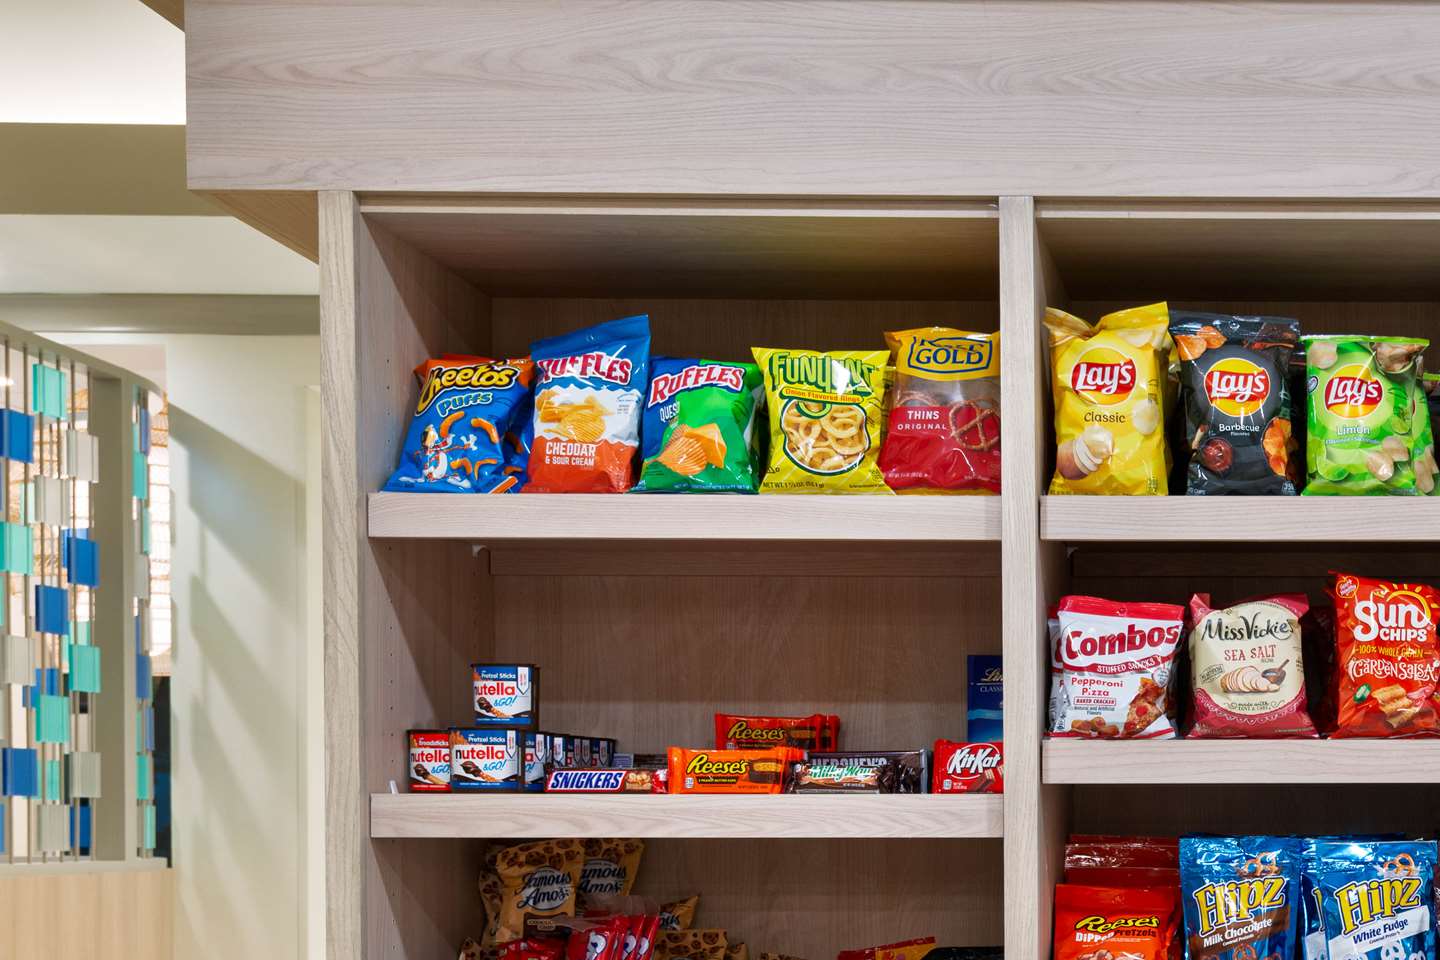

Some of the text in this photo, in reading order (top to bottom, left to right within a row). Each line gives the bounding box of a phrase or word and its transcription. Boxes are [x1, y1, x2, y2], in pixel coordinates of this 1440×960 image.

[916, 347, 984, 365] GOLD
[1076, 359, 1134, 395] Lay's
[416, 362, 519, 415] Cheetos
[648, 364, 744, 408] RUFFLES
[785, 387, 806, 398] Onion
[1211, 371, 1266, 402] Lay's
[1328, 378, 1380, 406] Lay's
[907, 410, 940, 420] THINS
[1084, 412, 1126, 424] Classic
[897, 423, 947, 431] ORIGINAL
[1219, 423, 1260, 433] Barbecue
[546, 441, 597, 457] CHEDDAR
[552, 456, 595, 467] SOUR CREAM
[1354, 599, 1432, 642] Sun
[1202, 618, 1244, 641] Miss
[1380, 627, 1427, 642] CHIPS
[1064, 623, 1180, 661] Combos
[1224, 645, 1276, 661] SEA SALT
[1358, 646, 1400, 657] 100% WHOLE
[1097, 657, 1156, 673] STUFFED SNACKS
[474, 682, 516, 696] nutella
[1071, 678, 1123, 688] Pepperoni
[1081, 687, 1110, 697] Pizza
[728, 721, 784, 740] Reese's
[455, 747, 504, 761] nutella
[950, 748, 1001, 772] KitKat
[685, 753, 749, 775] Reese's
[550, 772, 623, 789] SNICKERS
[1194, 876, 1286, 938] Flipz
[1334, 877, 1422, 938] Flipz
[1075, 915, 1161, 933] Reese's
[1353, 918, 1409, 944] White Fudge
[1115, 929, 1157, 938] PRETZELS
[1203, 918, 1273, 948] Milk Chocolate
